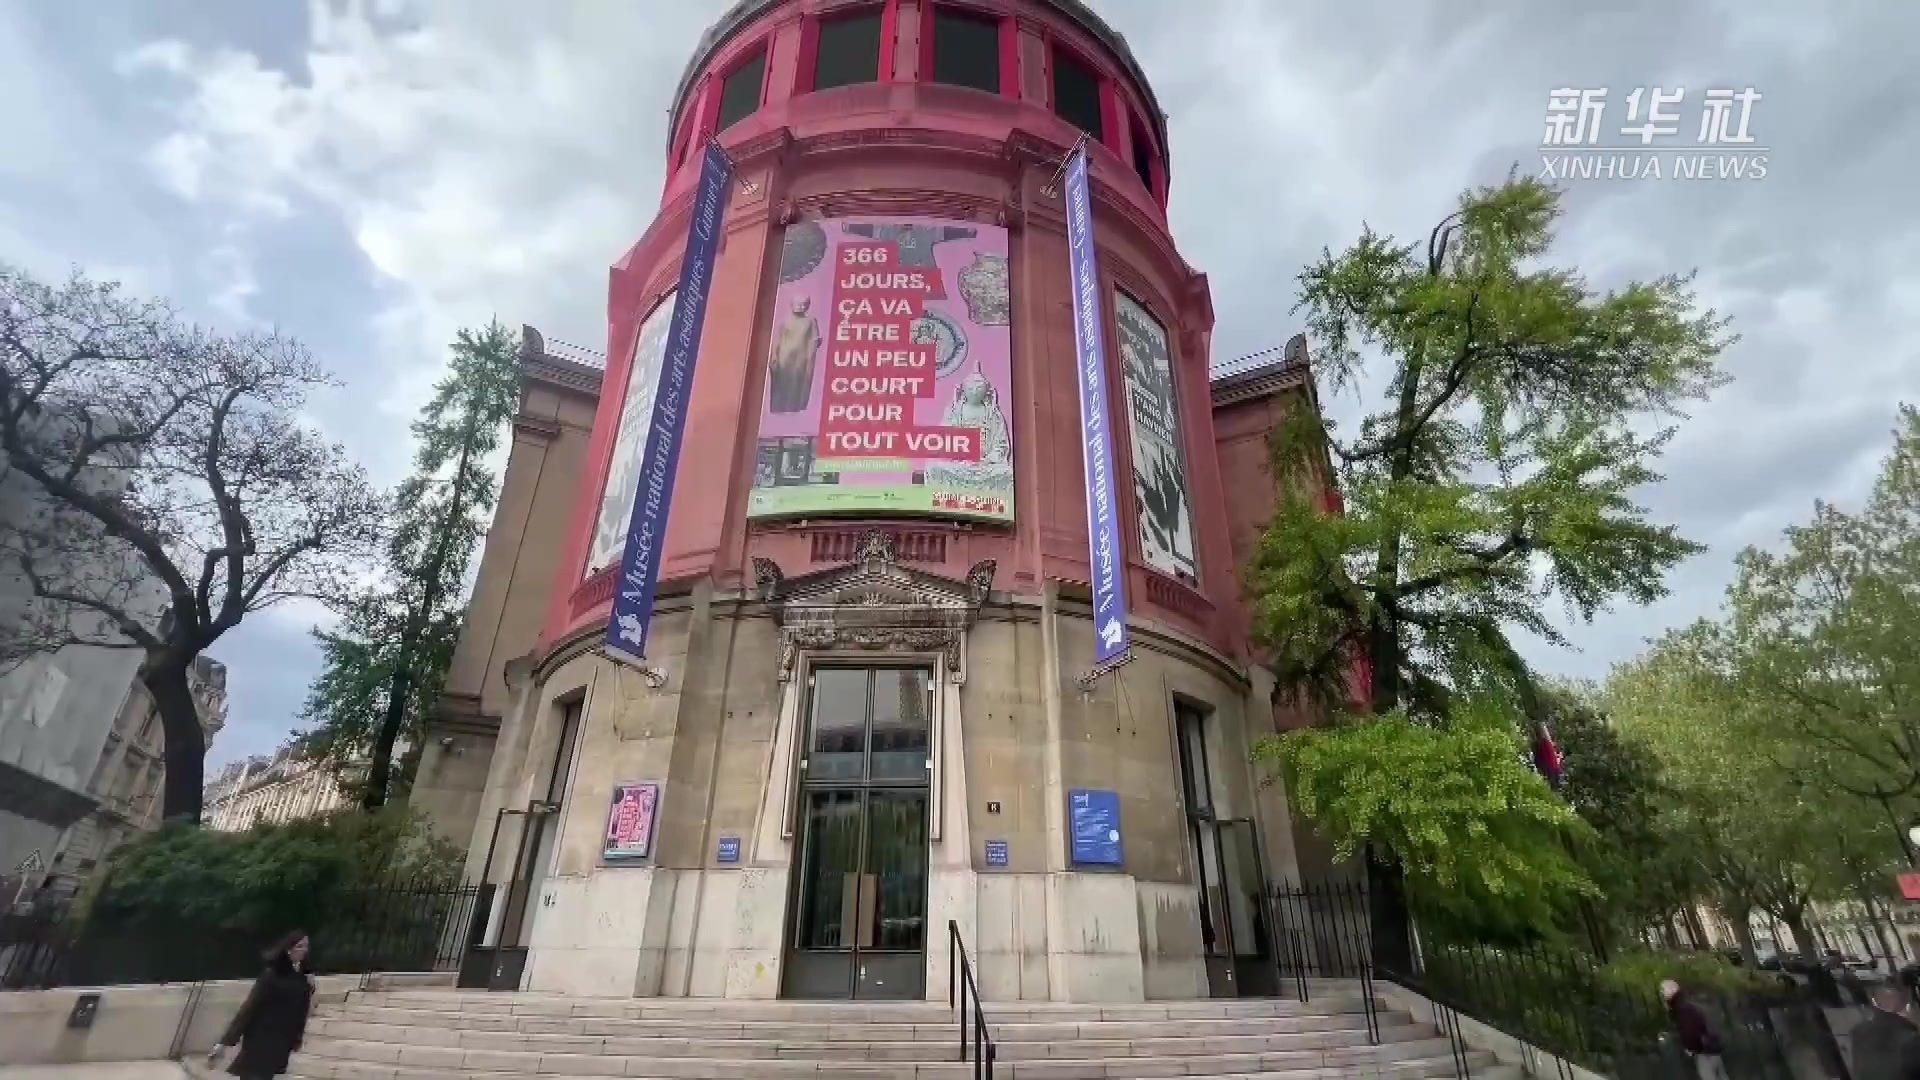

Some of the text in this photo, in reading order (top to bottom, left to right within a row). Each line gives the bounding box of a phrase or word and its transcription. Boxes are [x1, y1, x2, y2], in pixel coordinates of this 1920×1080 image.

[695, 176, 720, 241] Guimet
[843, 247, 888, 264] 366
[840, 272, 932, 292] JOURS,
[677, 256, 705, 349] asiatiques
[838, 298, 912, 317] ÇA VA
[836, 318, 900, 341] ÊTRE
[671, 348, 689, 391] arts
[833, 350, 926, 367] UN PEU
[831, 377, 924, 395] COURT
[659, 387, 679, 428] des
[827, 403, 903, 421] POUR
[1087, 391, 1103, 430] des
[825, 431, 971, 453] TOUT VOIR
[645, 423, 672, 519] national
[1089, 433, 1109, 525] national
[622, 521, 654, 605] Musée
[1097, 525, 1114, 612] Musée
